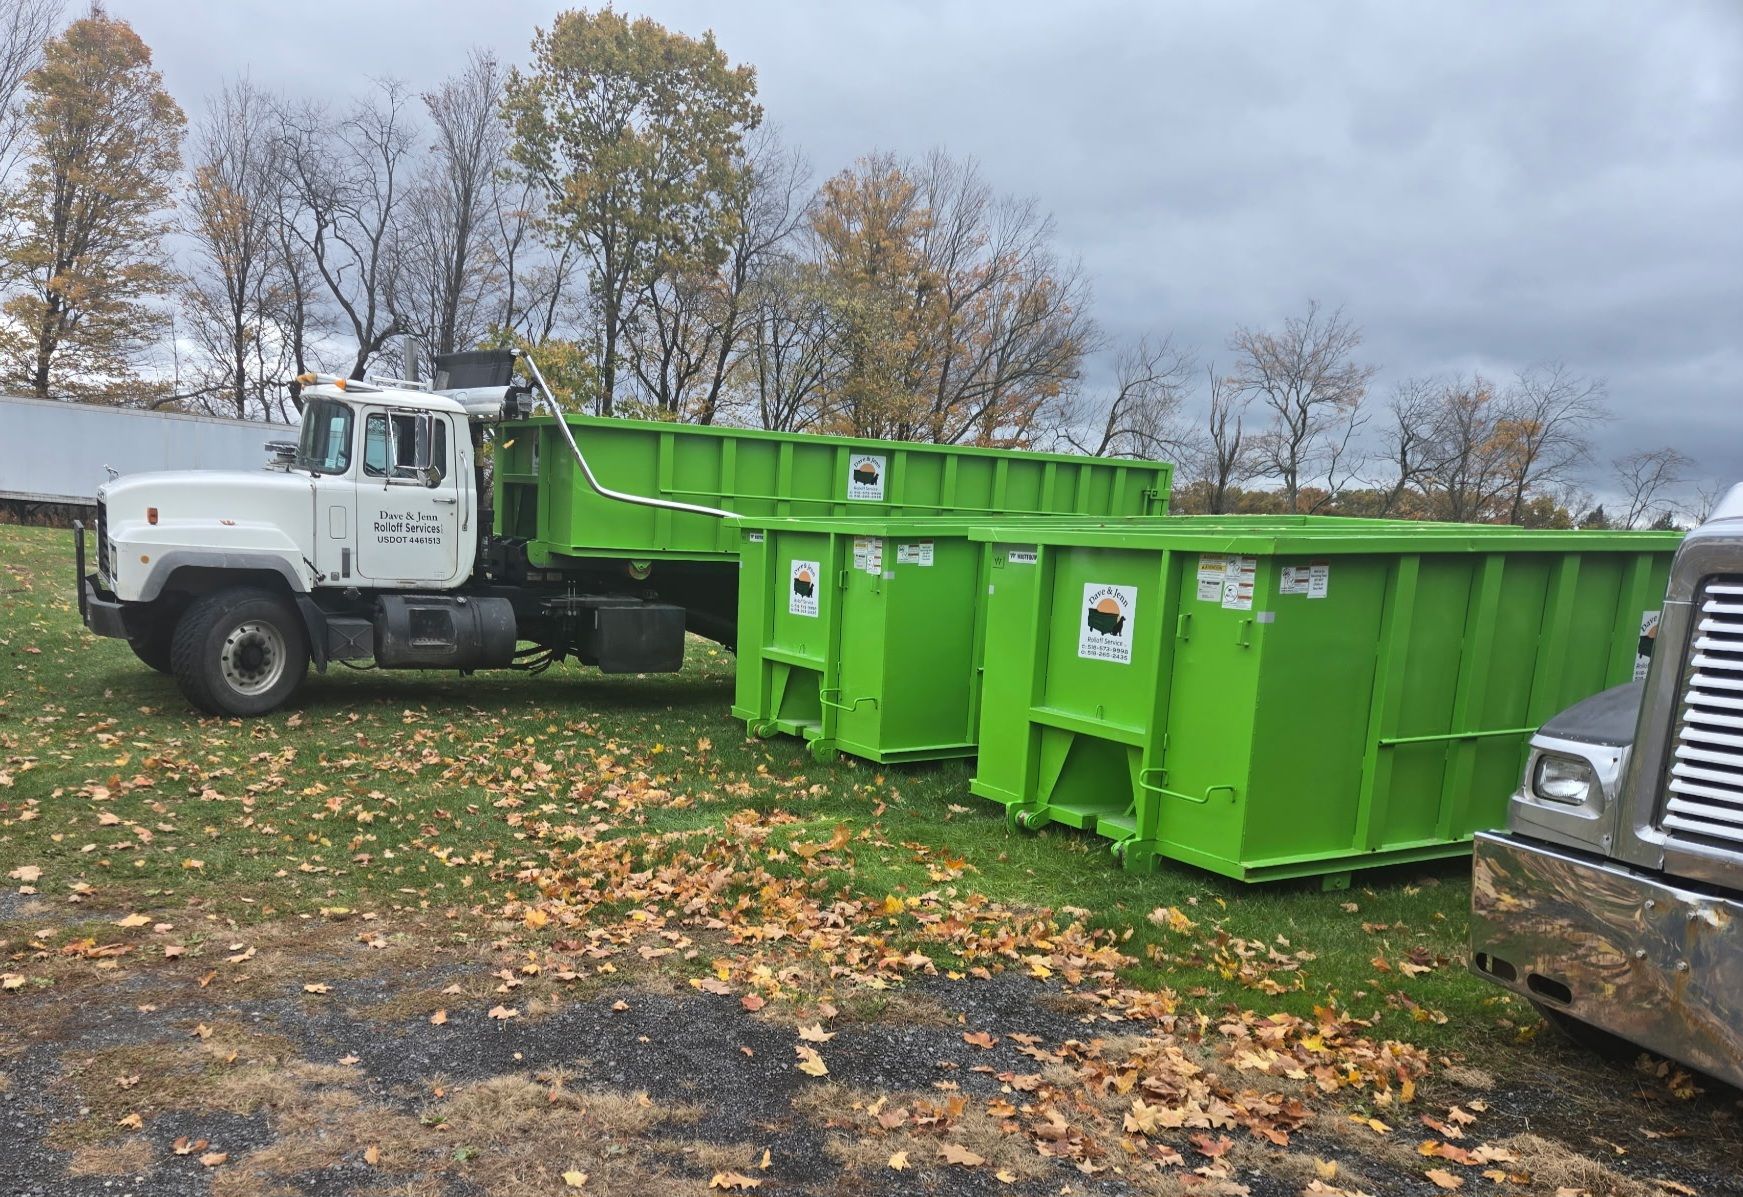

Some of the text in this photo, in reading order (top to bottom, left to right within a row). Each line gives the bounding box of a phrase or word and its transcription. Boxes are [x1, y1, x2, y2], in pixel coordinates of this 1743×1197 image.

[380, 510, 438, 522] Dave & Jenn
[374, 522, 403, 532] Rolloff
[405, 523, 440, 533] Services
[1088, 586, 1128, 608] Dave & Jenn
[1641, 615, 1657, 632] Dave
[1104, 638, 1123, 647] Service
